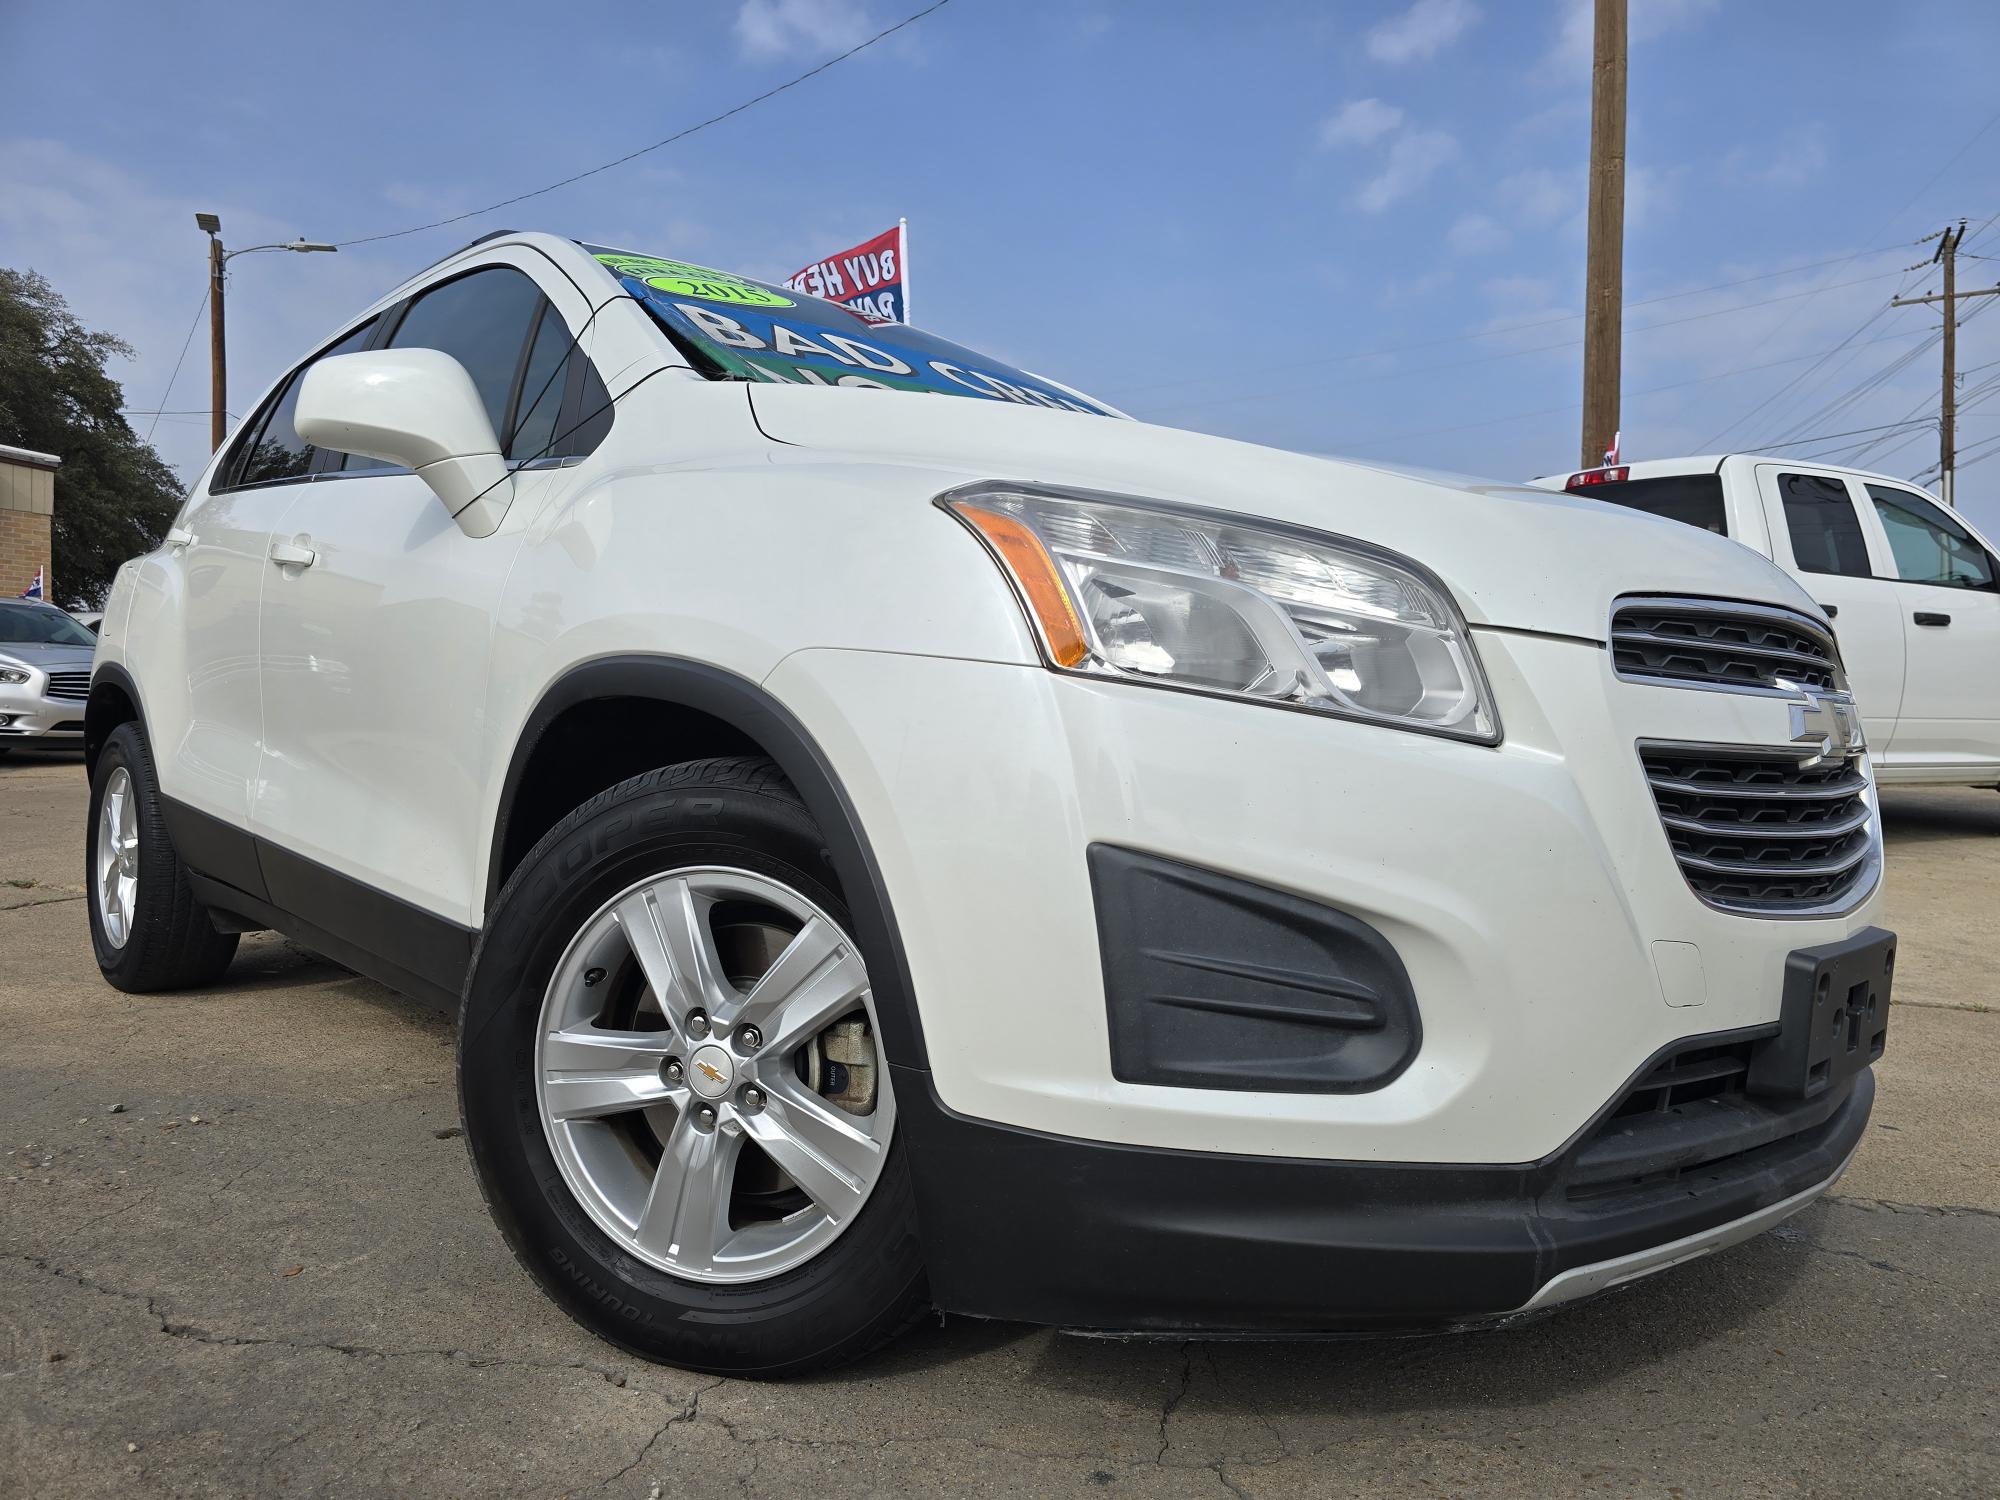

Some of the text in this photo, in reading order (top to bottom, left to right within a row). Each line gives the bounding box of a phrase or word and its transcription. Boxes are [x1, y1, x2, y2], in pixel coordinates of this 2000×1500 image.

[676, 279, 772, 303] 2015
[672, 303, 914, 375] BAD
[549, 1246, 656, 1328] TOURING
